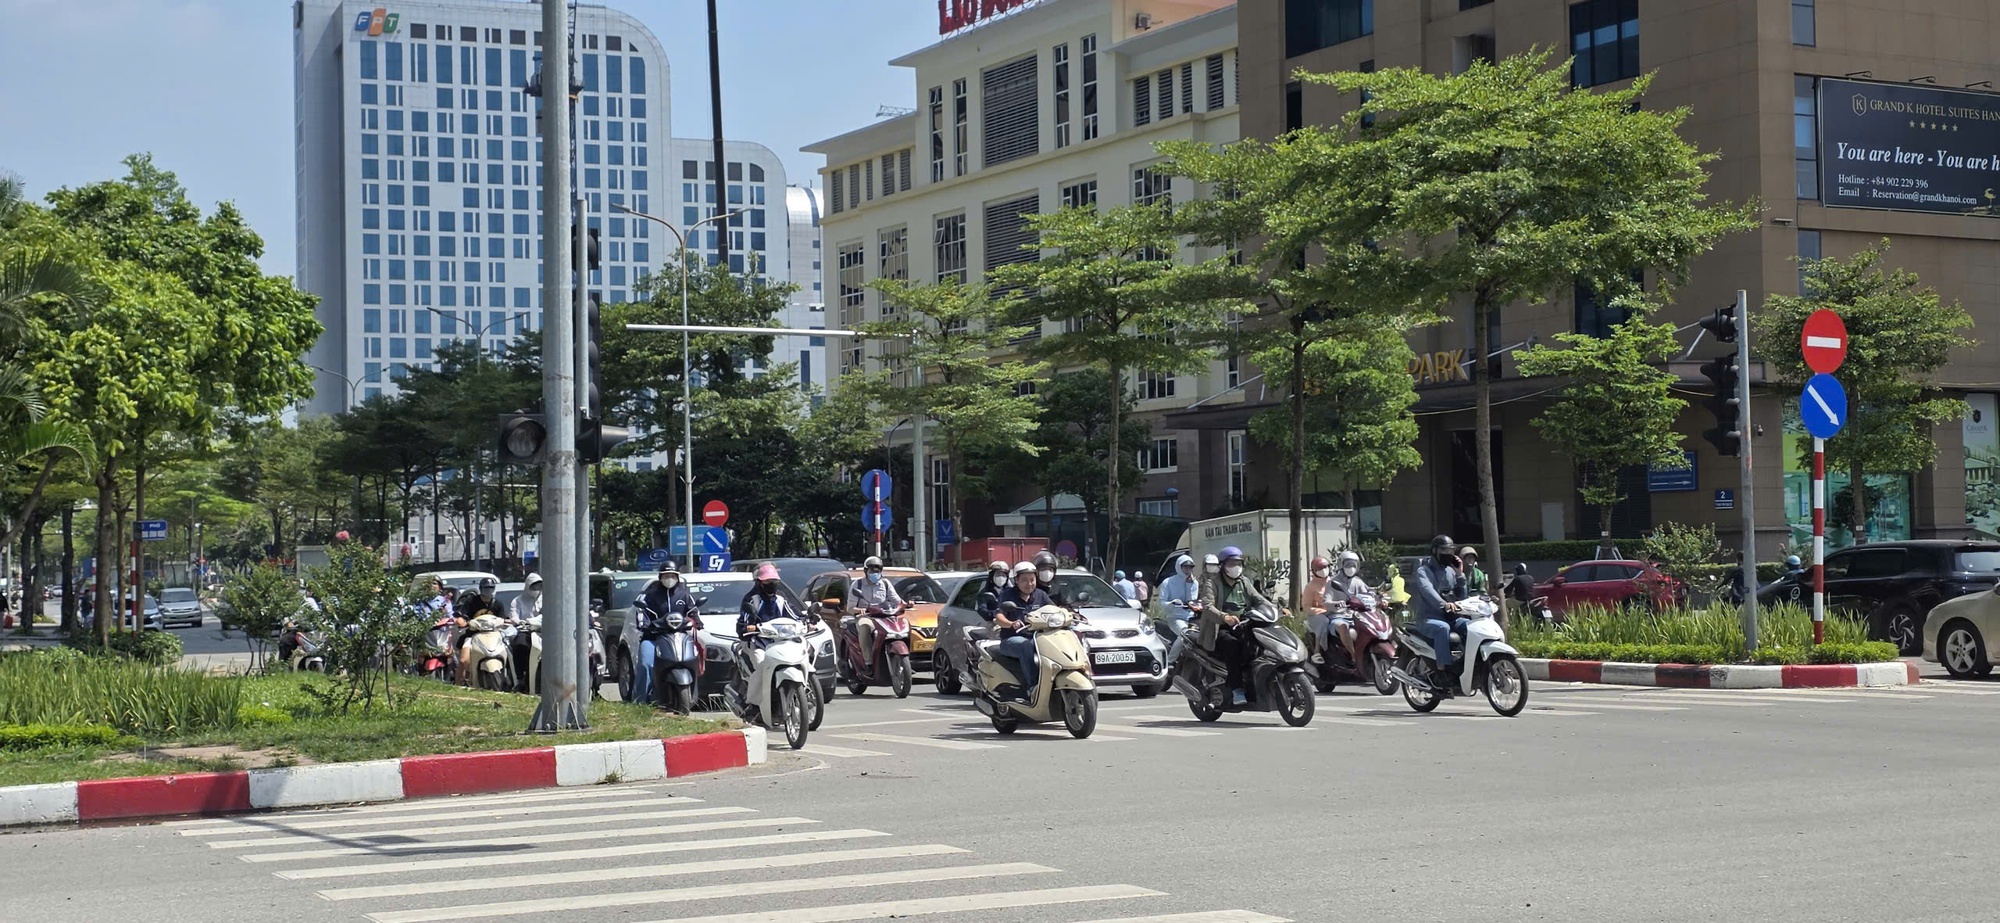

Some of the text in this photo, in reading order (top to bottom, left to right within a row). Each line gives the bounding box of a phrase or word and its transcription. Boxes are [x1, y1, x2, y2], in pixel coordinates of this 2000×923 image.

[356, 12, 398, 31] FPT
[1870, 99, 1905, 113] GRAND
[1906, 102, 1914, 113] K
[1916, 103, 1947, 117] HOTEL
[1948, 106, 1980, 120] SUITES
[1837, 142, 1866, 161] You
[1869, 149, 1891, 163] are
[1894, 146, 1925, 165] here
[1937, 150, 1964, 169] You
[1966, 157, 1989, 170] are
[1838, 173, 1865, 185] Hotline
[1871, 176, 1885, 186] +84
[1886, 177, 1900, 187] 902
[1901, 178, 1914, 188] 229
[1915, 179, 1929, 189] 396
[1838, 186, 1860, 197] Email
[1872, 188, 1977, 205] Reservation@grandkhanoi.com
[1405, 350, 1468, 384] PARK
[1720, 490, 1726, 499] 2
[709, 555, 725, 571] G7
